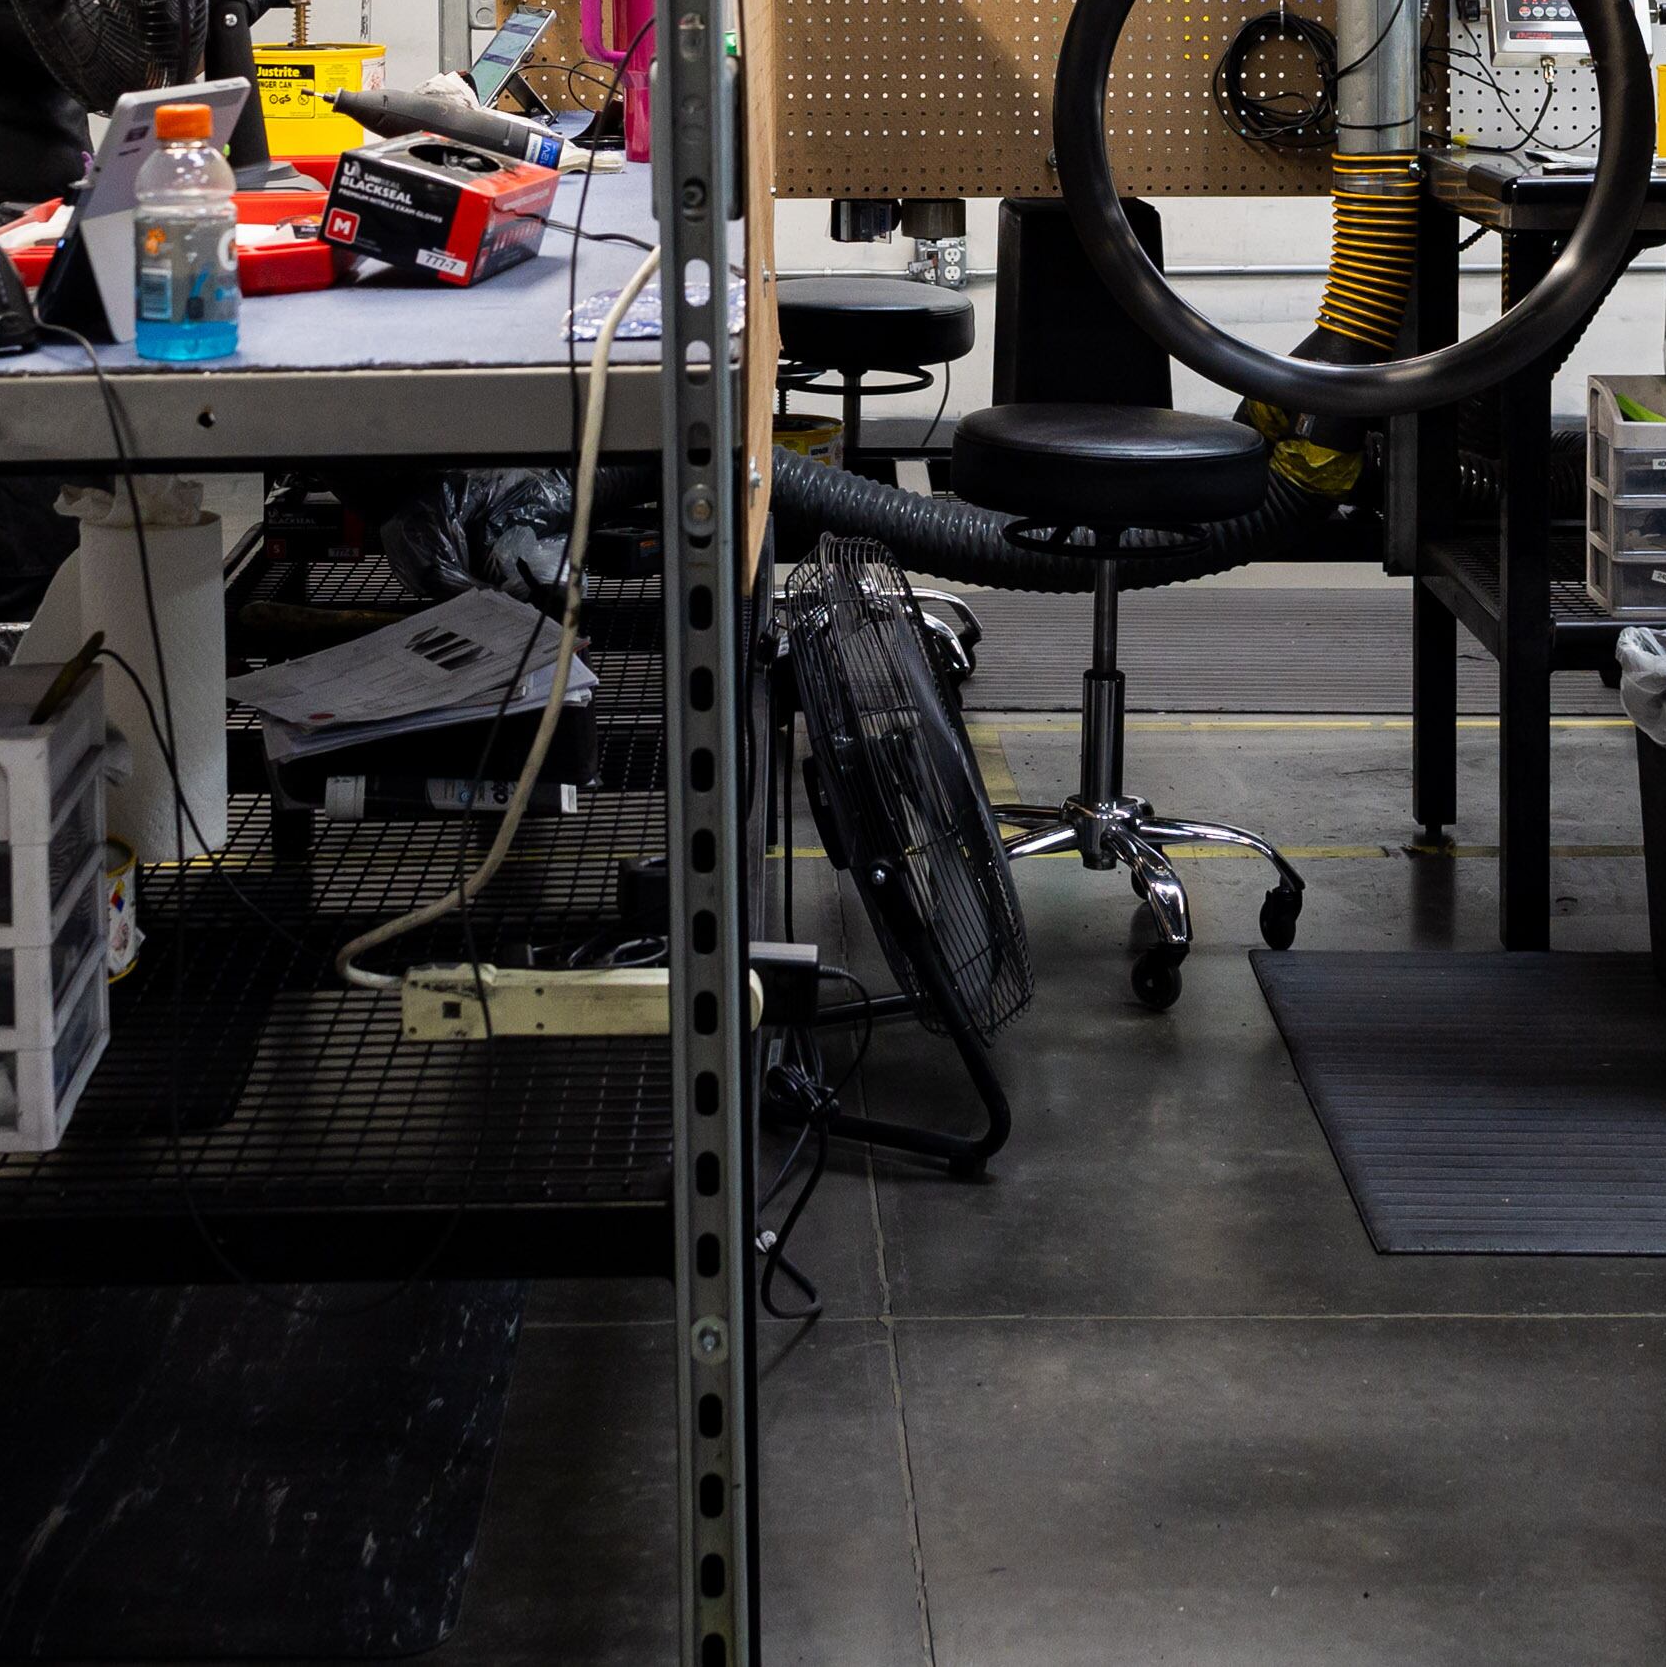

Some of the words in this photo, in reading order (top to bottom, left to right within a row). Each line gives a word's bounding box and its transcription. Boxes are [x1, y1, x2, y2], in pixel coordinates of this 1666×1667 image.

[256, 66, 301, 78] Justrite
[278, 81, 293, 89] CAN
[339, 175, 413, 205] BLACKSEAL
[337, 188, 369, 203] PREMIUM
[368, 196, 395, 210] NITRILE
[394, 202, 416, 215] EXAM
[415, 208, 443, 224] GLOVES
[333, 218, 352, 235] M
